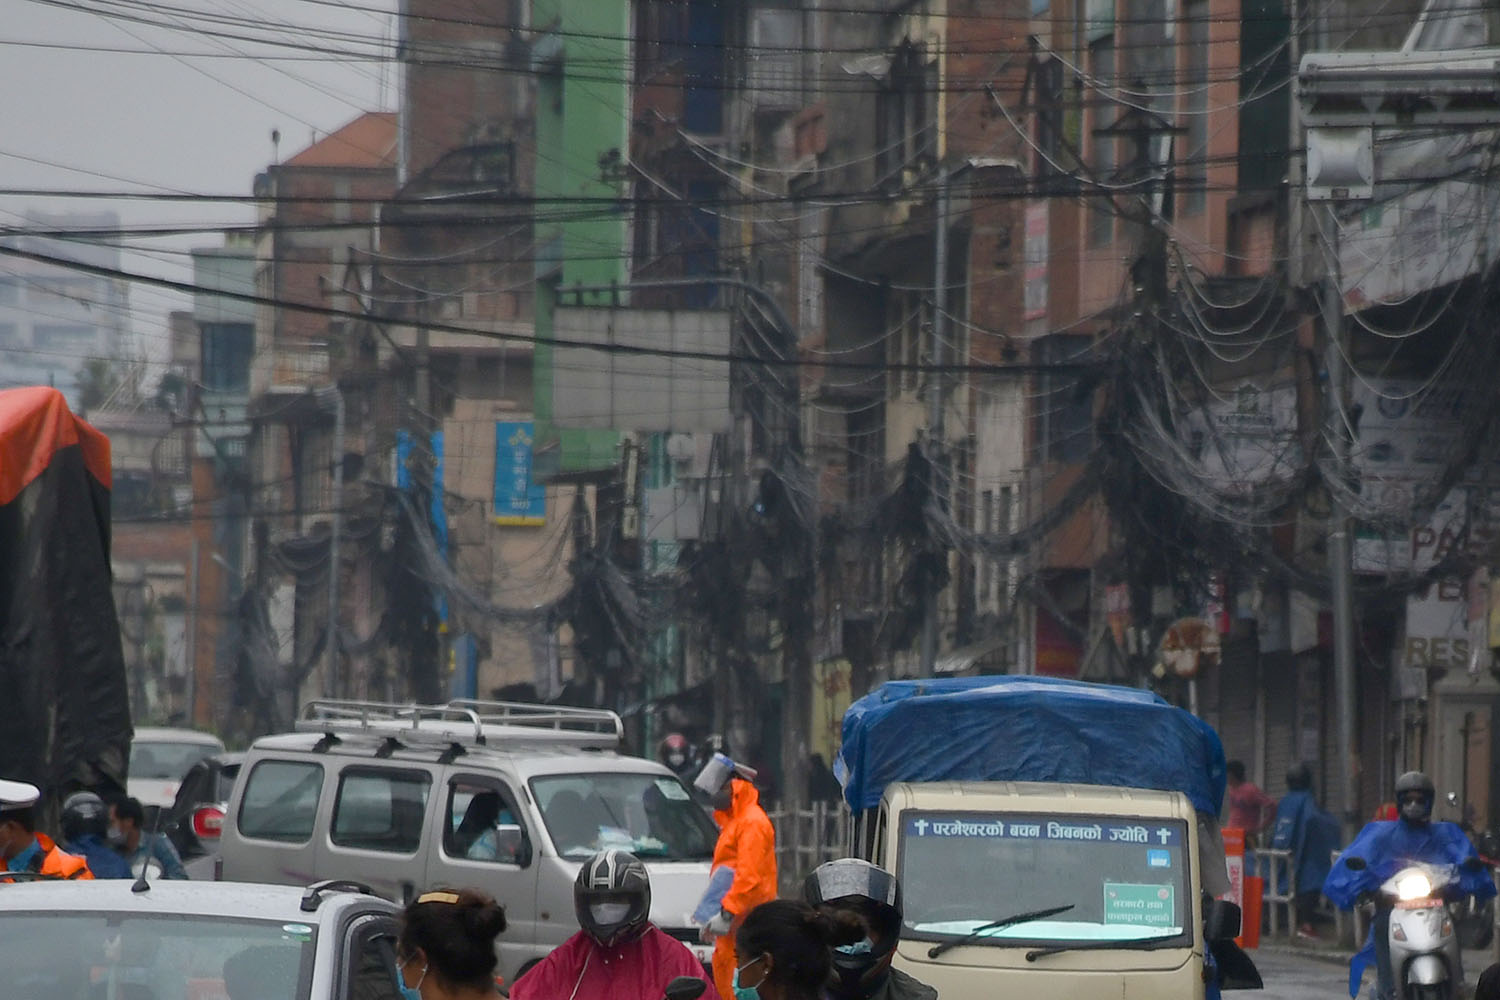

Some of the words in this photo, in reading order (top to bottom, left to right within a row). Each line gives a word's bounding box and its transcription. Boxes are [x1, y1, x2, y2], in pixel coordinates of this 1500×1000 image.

[932, 820, 1004, 838] परमेश्वरको
[1010, 823, 1041, 838] बचन
[1047, 820, 1102, 840] जिबनको
[1108, 826, 1149, 843] ज्योति
